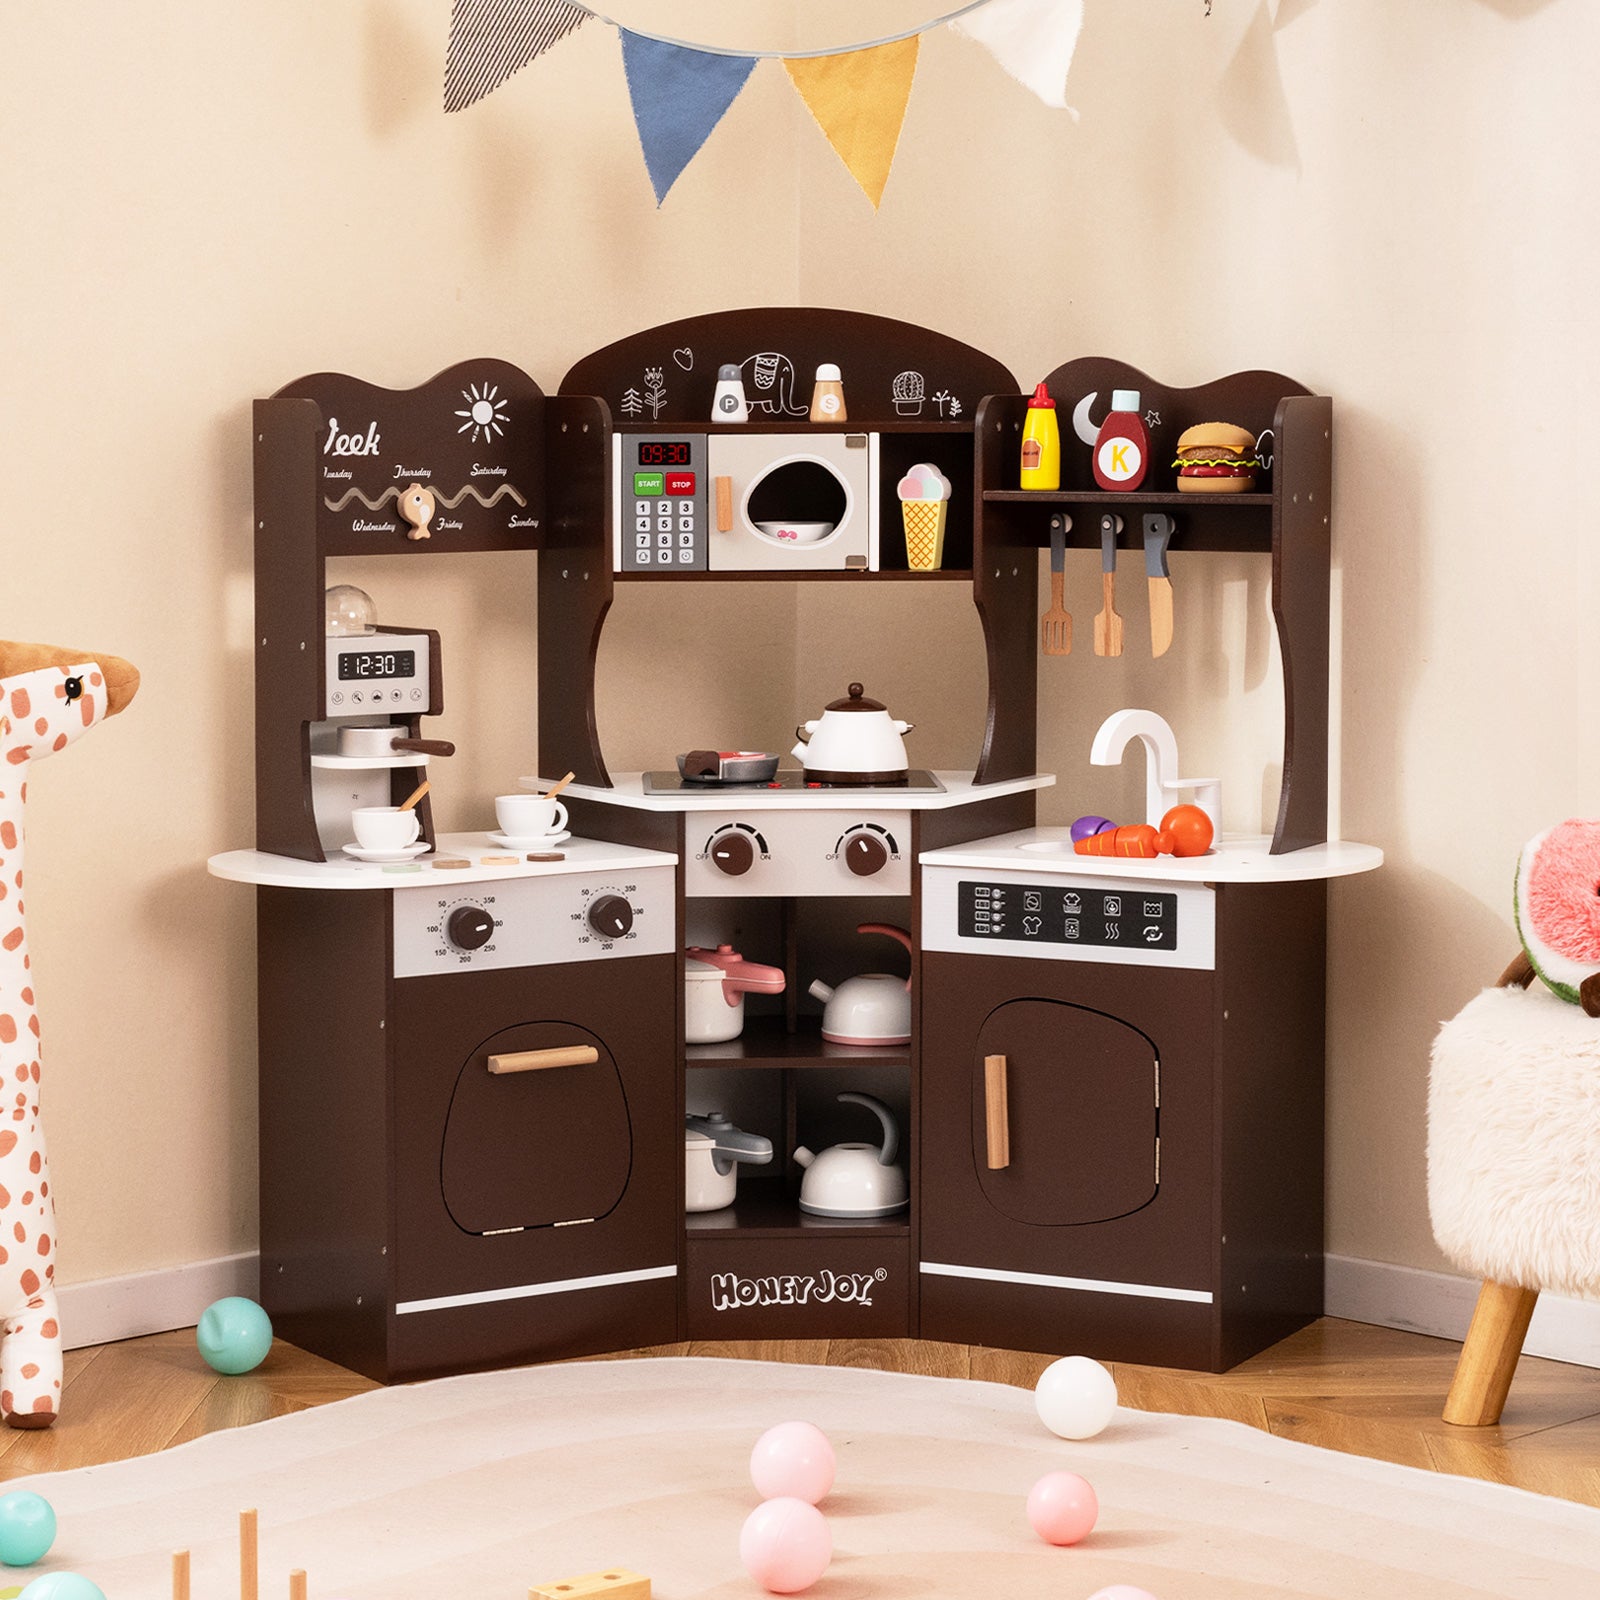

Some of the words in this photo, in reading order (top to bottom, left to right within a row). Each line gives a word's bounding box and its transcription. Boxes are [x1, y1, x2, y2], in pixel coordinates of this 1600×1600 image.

[725, 398, 735, 410] P
[824, 397, 836, 410] S
[641, 444, 688, 464] 09:30
[1111, 445, 1130, 473] K
[392, 464, 432, 479] Thursday
[469, 463, 508, 477] Saturday
[638, 479, 660, 488] START
[671, 480, 692, 489] STOP
[640, 503, 645, 513] 1
[661, 503, 668, 513] 2
[683, 503, 690, 513] 3
[352, 519, 397, 533] Wednesday
[436, 517, 464, 531] Friday
[508, 514, 540, 529] Sunday
[640, 519, 647, 529] 4
[661, 519, 668, 529] 5
[683, 519, 690, 529] 6
[640, 535, 647, 545] 7
[661, 535, 668, 545] 8
[683, 535, 690, 545] 9
[661, 551, 668, 561] 0
[356, 654, 396, 676] 12:30
[695, 853, 710, 861] OFF
[760, 853, 772, 861] ON
[825, 853, 840, 861] OFF
[890, 853, 902, 861] ON
[581, 888, 590, 896] 50
[438, 900, 447, 908] 50
[570, 913, 582, 921] 100
[494, 919, 504, 928] 00
[426, 925, 439, 933] 100
[578, 936, 590, 944] 150
[624, 931, 637, 940] 250
[483, 944, 496, 953] 250
[601, 943, 614, 951] 200
[434, 948, 448, 956] 150
